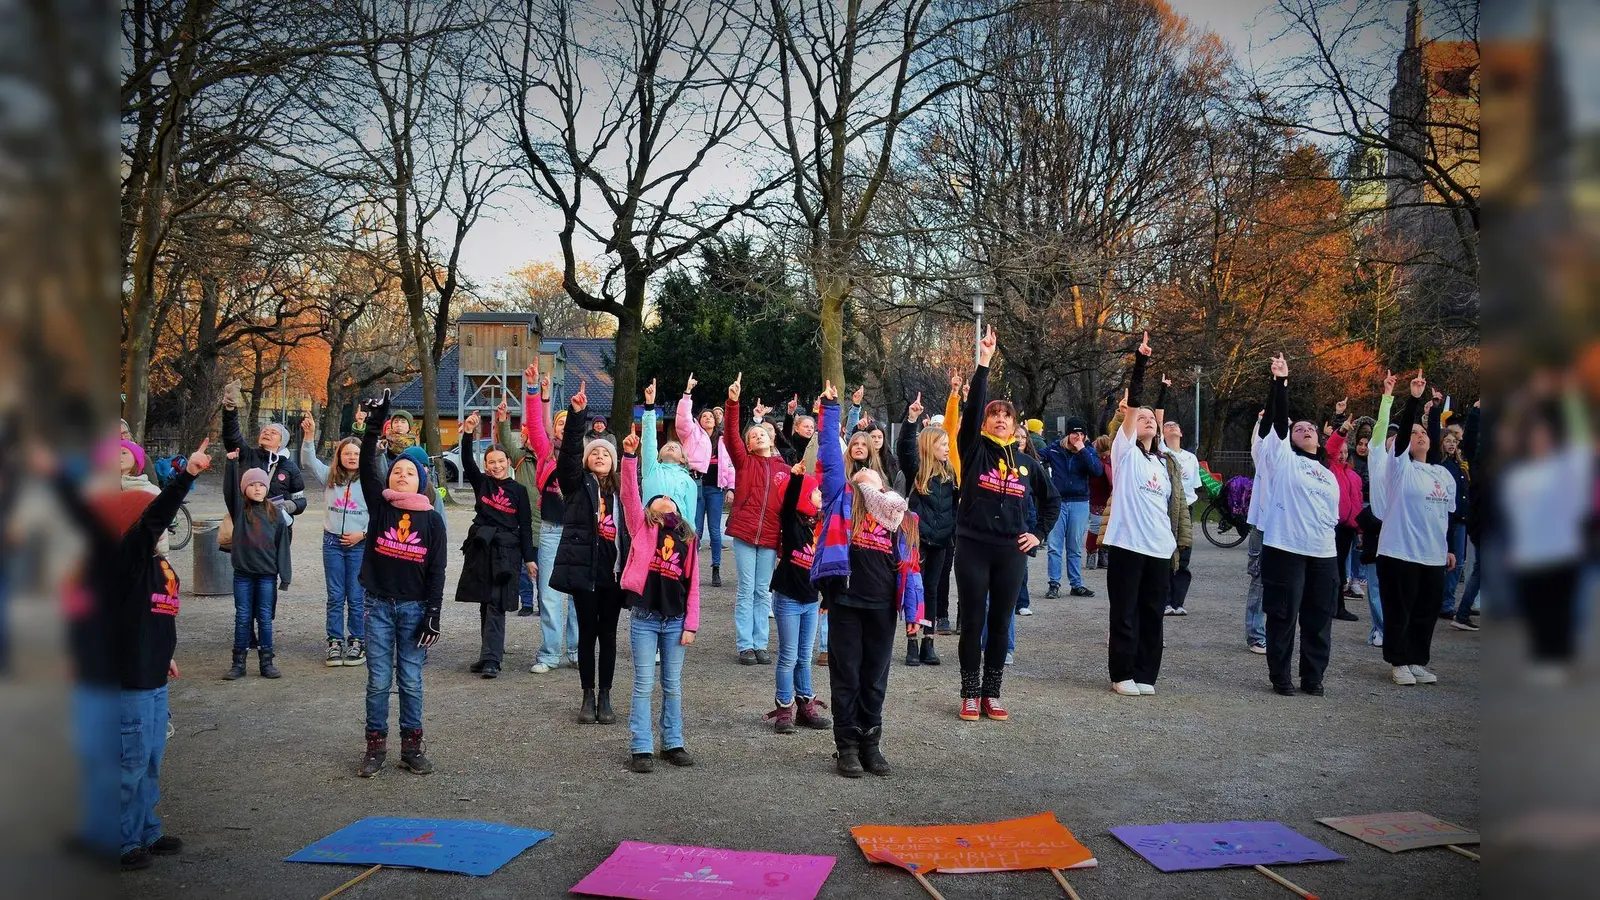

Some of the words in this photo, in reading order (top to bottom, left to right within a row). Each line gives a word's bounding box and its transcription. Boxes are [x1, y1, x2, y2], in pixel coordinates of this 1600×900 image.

[151, 593, 166, 604] ONE
[858, 836, 899, 845] RISE
[906, 836, 950, 845] FOR
[972, 834, 1017, 843] THE
[872, 844, 945, 853] BODIES
[990, 841, 1035, 849] FOR
